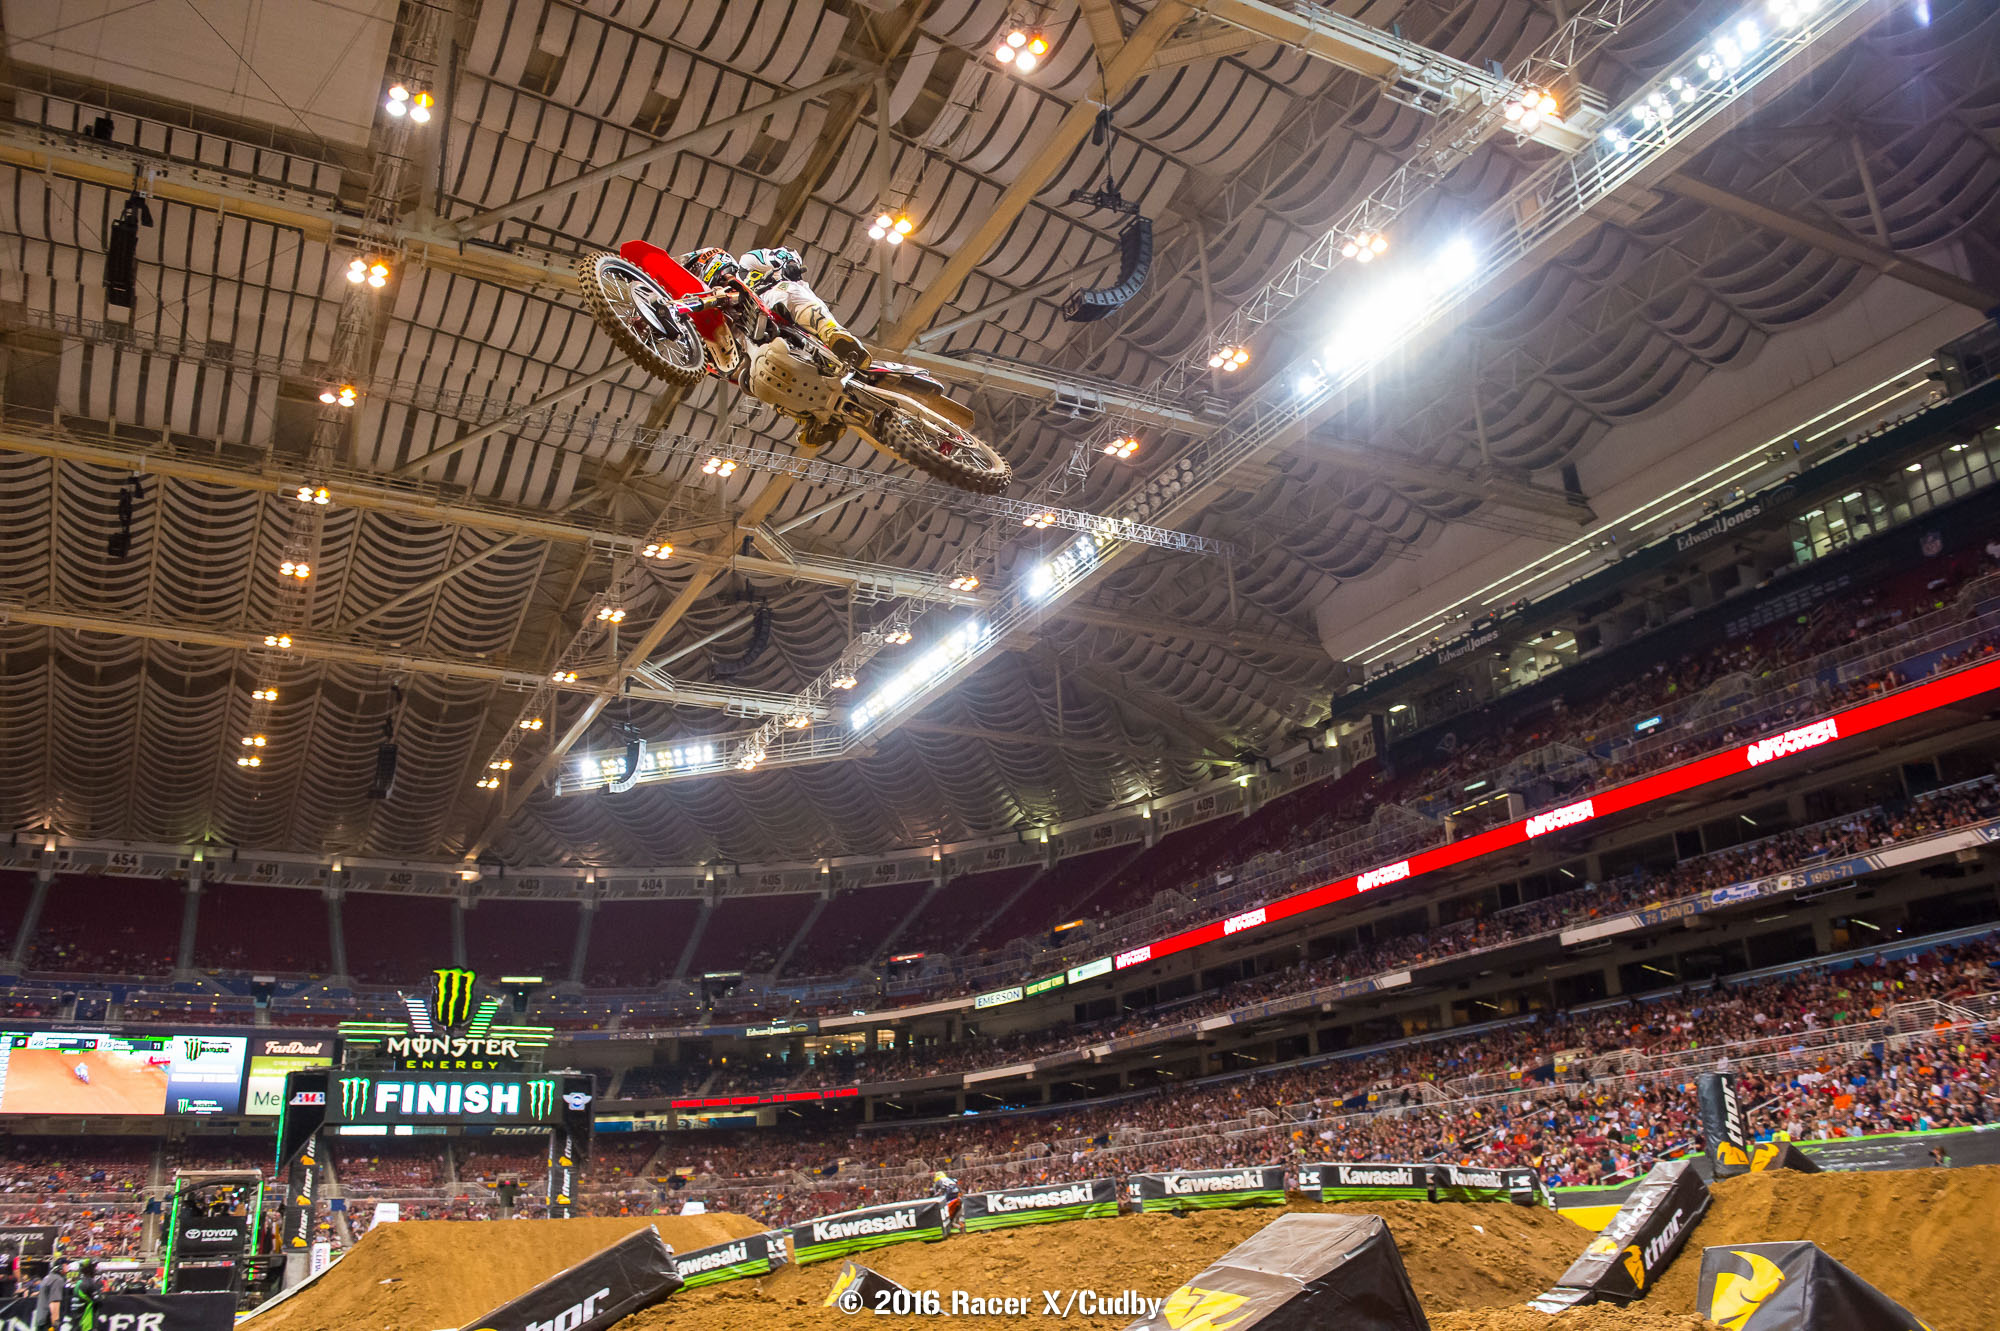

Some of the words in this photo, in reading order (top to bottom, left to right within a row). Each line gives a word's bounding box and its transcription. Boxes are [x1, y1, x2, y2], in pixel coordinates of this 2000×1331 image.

[112, 853, 138, 866] 454
[256, 863, 279, 876] 401
[389, 873, 412, 885] 402
[518, 879, 540, 890] 403
[641, 879, 663, 890] 404
[1660, 903, 1695, 921] DAVID
[977, 990, 1021, 1007] EMERSON
[16, 1039, 26, 1047] 9
[85, 1040, 96, 1048] 10
[265, 1040, 323, 1055] FanDuel
[387, 1035, 520, 1058] MONSTER
[406, 1060, 499, 1069] ENERGY
[375, 1082, 521, 1114] FINISH
[1721, 1076, 1744, 1147] thor
[1163, 1170, 1264, 1195] Kawasaki
[1339, 1167, 1413, 1186] Kawasaki
[1449, 1167, 1504, 1188] Kawasaki
[986, 1183, 1094, 1213] Kawasaki
[200, 1228, 238, 1238] TOYOTA
[812, 1209, 917, 1242] Kawasaki
[1644, 1208, 1684, 1270] thor
